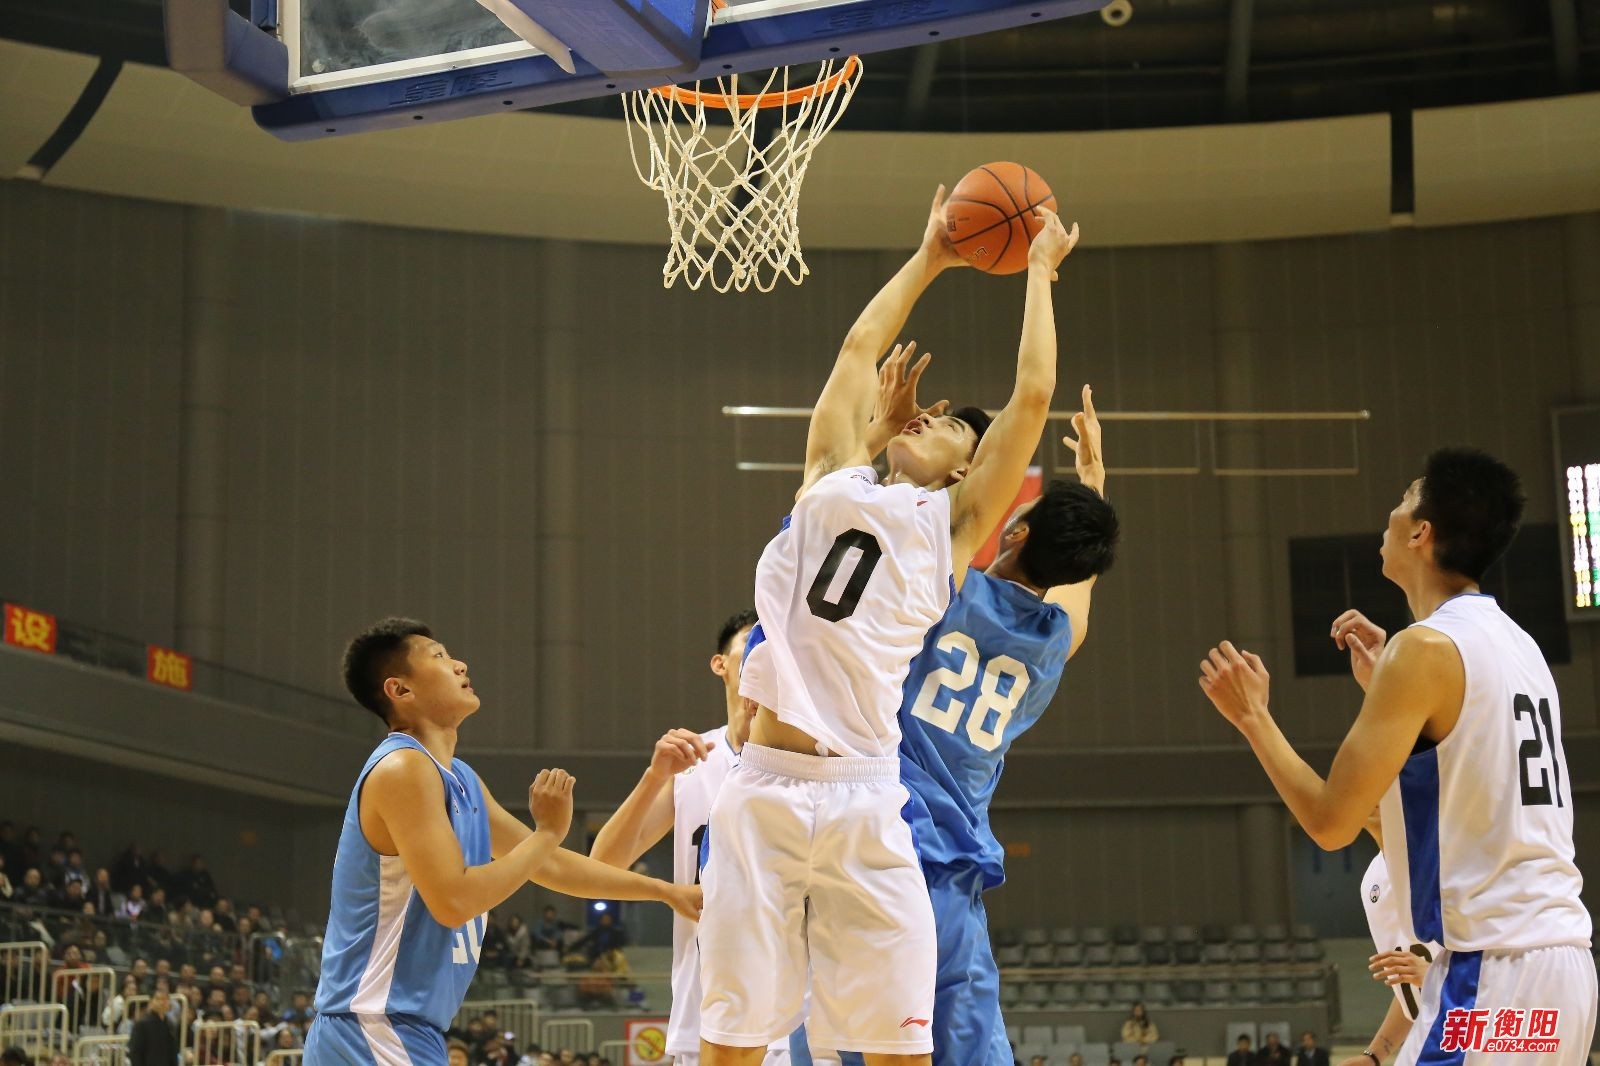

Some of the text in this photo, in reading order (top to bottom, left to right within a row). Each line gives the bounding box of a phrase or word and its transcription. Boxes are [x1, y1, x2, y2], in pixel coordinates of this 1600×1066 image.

[806, 528, 882, 623] 0
[11, 606, 52, 651] 设
[910, 631, 1031, 752] 28
[1513, 693, 1564, 808] 21
